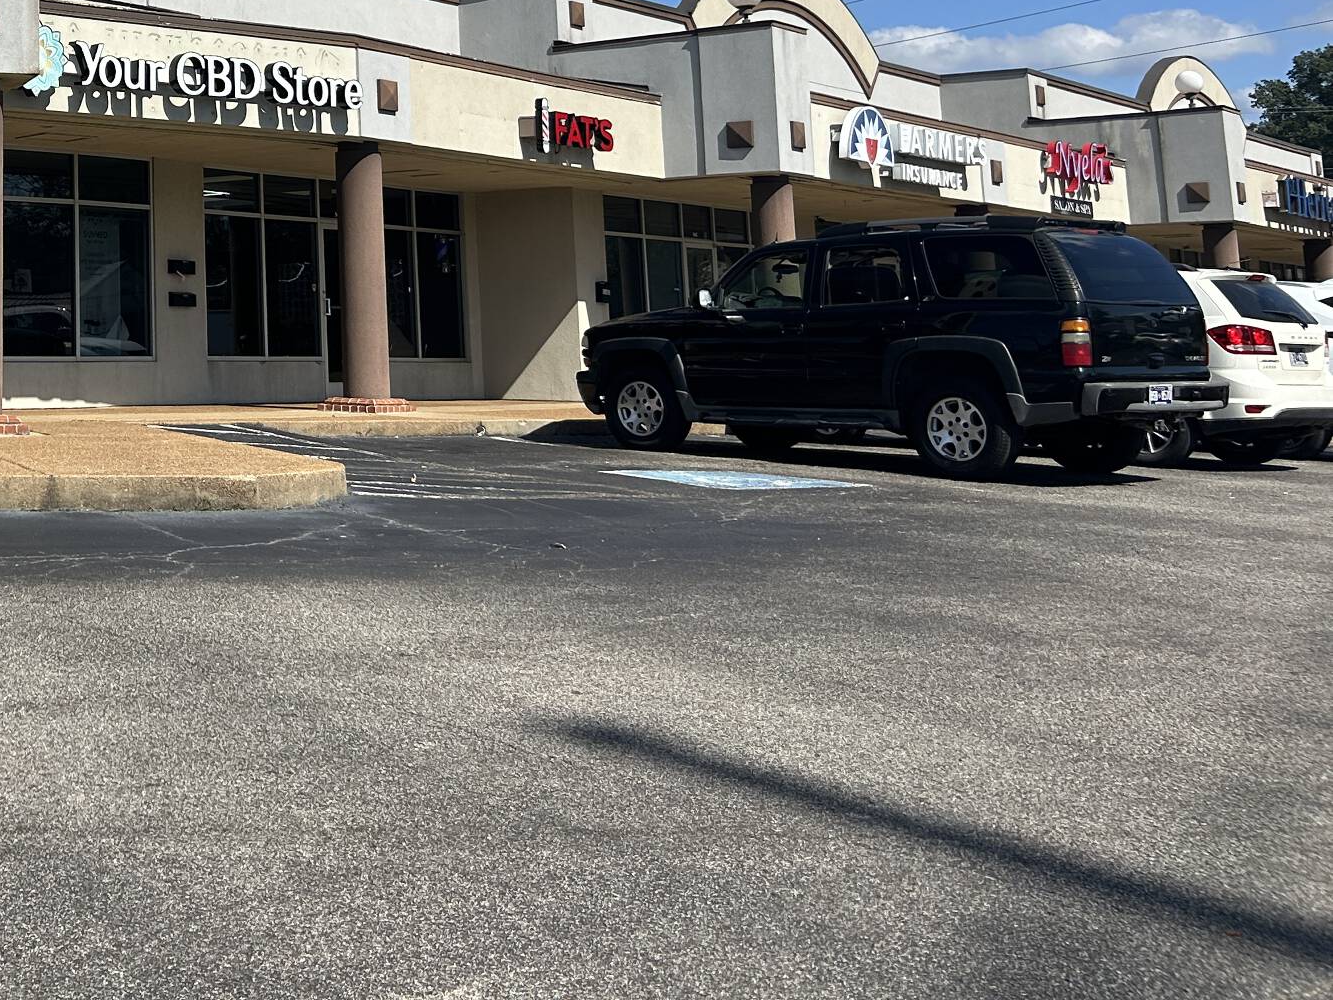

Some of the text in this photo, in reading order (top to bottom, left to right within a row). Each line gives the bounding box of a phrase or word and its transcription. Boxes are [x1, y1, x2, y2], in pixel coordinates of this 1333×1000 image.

[71, 39, 364, 110] Your CBD Store
[554, 111, 615, 152] FAT'S
[901, 163, 964, 189] INSURANCE
[1054, 199, 1093, 215] SALON & SPA
